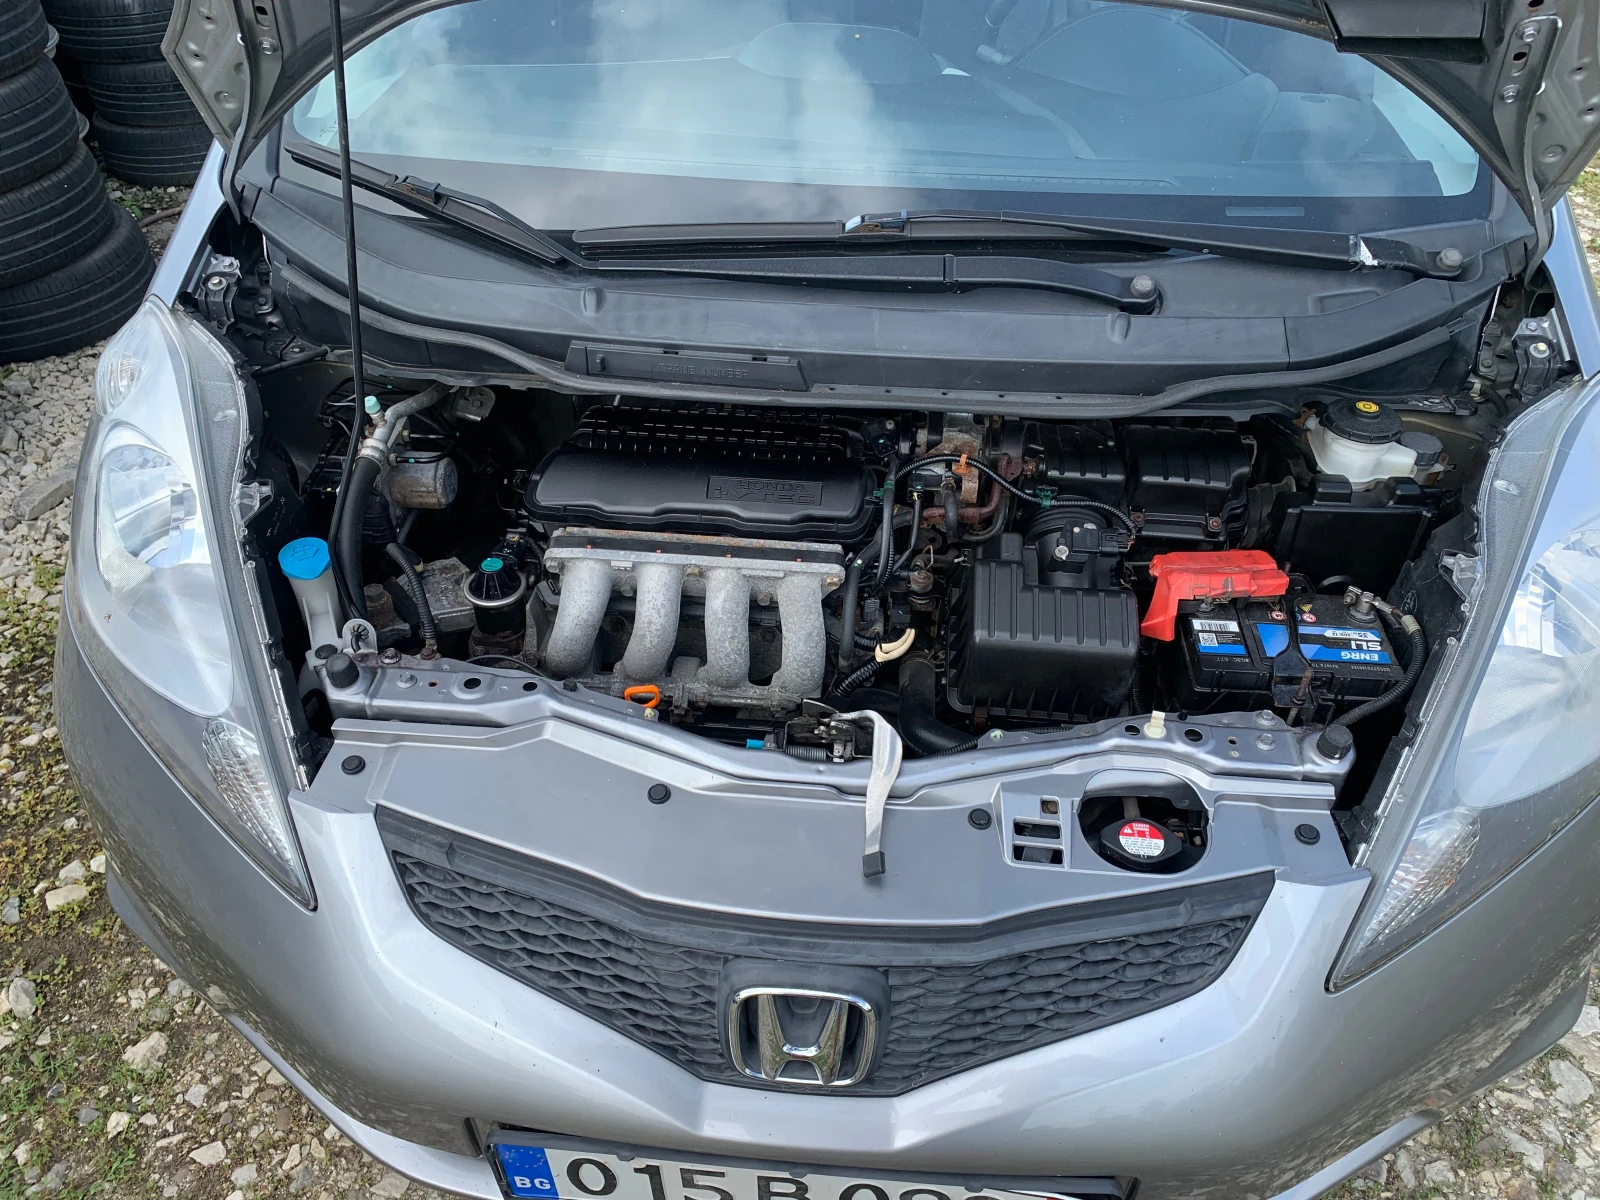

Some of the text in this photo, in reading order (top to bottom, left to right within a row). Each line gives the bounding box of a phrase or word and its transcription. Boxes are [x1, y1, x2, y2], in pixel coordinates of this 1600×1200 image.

[658, 362, 750, 380] FRAME NUMBER
[736, 480, 808, 493] HONDA
[1340, 650, 1379, 661] ENRG
[513, 1175, 551, 1190] BG
